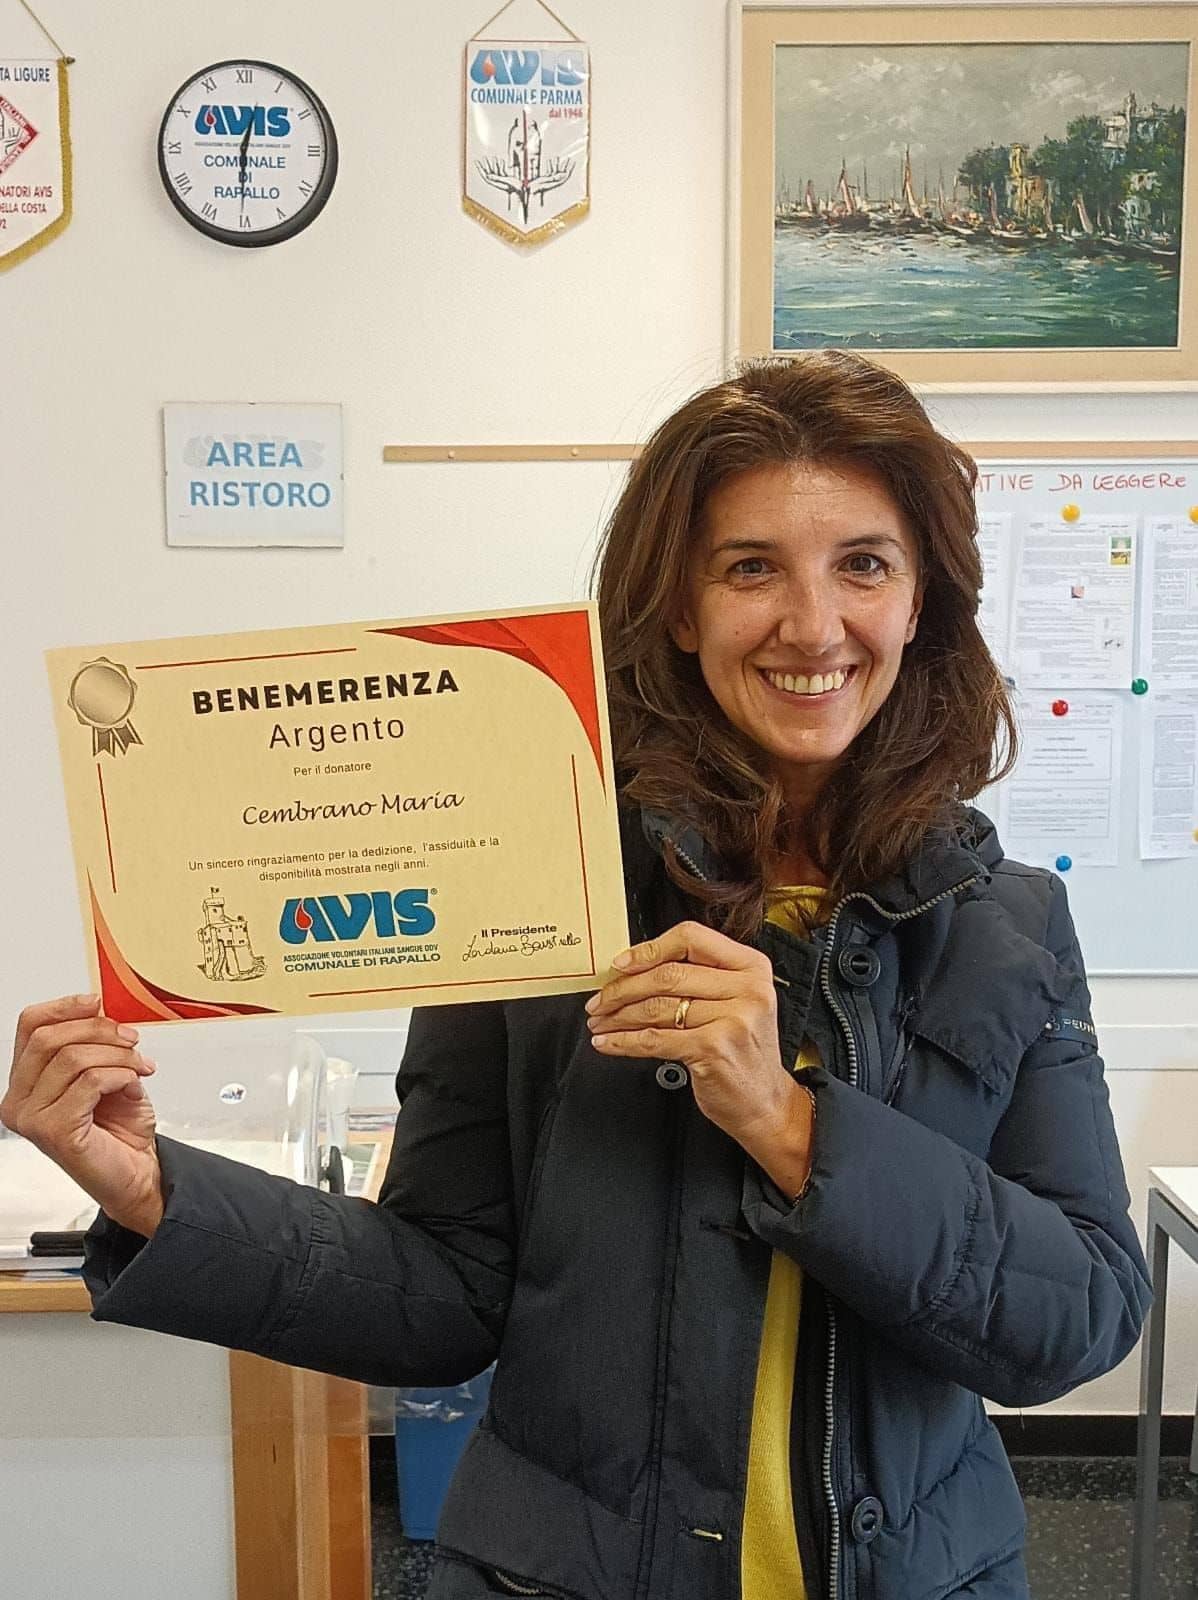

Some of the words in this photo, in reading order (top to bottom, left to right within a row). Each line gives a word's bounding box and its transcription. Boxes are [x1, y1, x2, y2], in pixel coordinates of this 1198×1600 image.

[14, 67, 50, 82] LIGURE
[236, 69, 253, 84] XII
[470, 50, 585, 86] AVIS
[201, 76, 217, 93] XI
[471, 88, 537, 104] COMUNALE
[540, 89, 583, 105] PARMA
[176, 105, 191, 119] X
[195, 104, 291, 137] AVIS
[549, 108, 562, 118] dal
[34, 186, 52, 198] AVIS
[214, 186, 280, 200] RAPALLO
[21, 203, 47, 214] COSTA
[201, 202, 218, 221] VII
[206, 442, 304, 468] AREA
[1049, 473, 1082, 491] DA
[189, 481, 332, 508] RISTORO
[192, 670, 459, 715] BENEMERENZA
[269, 717, 405, 753] Argento
[293, 766, 312, 777] Per
[315, 765, 321, 775] il
[324, 761, 372, 774] donatore
[242, 800, 377, 826] Cembrano
[380, 790, 465, 815] Maria
[188, 860, 204, 871] Un
[206, 858, 244, 870] sincero
[247, 852, 326, 868] ringraziamento
[328, 850, 345, 862] per
[348, 848, 359, 859] la
[361, 844, 418, 858] dedizione,
[422, 837, 477, 853] l'assiduità
[479, 838, 487, 847] e
[489, 836, 500, 846] la
[259, 868, 322, 882] disponibilità
[324, 862, 371, 876] mostrata
[374, 859, 401, 873] negli
[403, 857, 430, 870] anni.
[481, 929, 490, 938] Il
[490, 925, 558, 938] Presidente
[283, 953, 331, 963] ASSOCIAZIONE
[332, 949, 369, 959] VOLONTARI
[368, 947, 397, 956] ITALIANI
[396, 944, 424, 953] SANGUE
[284, 958, 361, 973] COMUNALE
[363, 957, 377, 967] DI
[379, 952, 441, 966] RAPALLO
